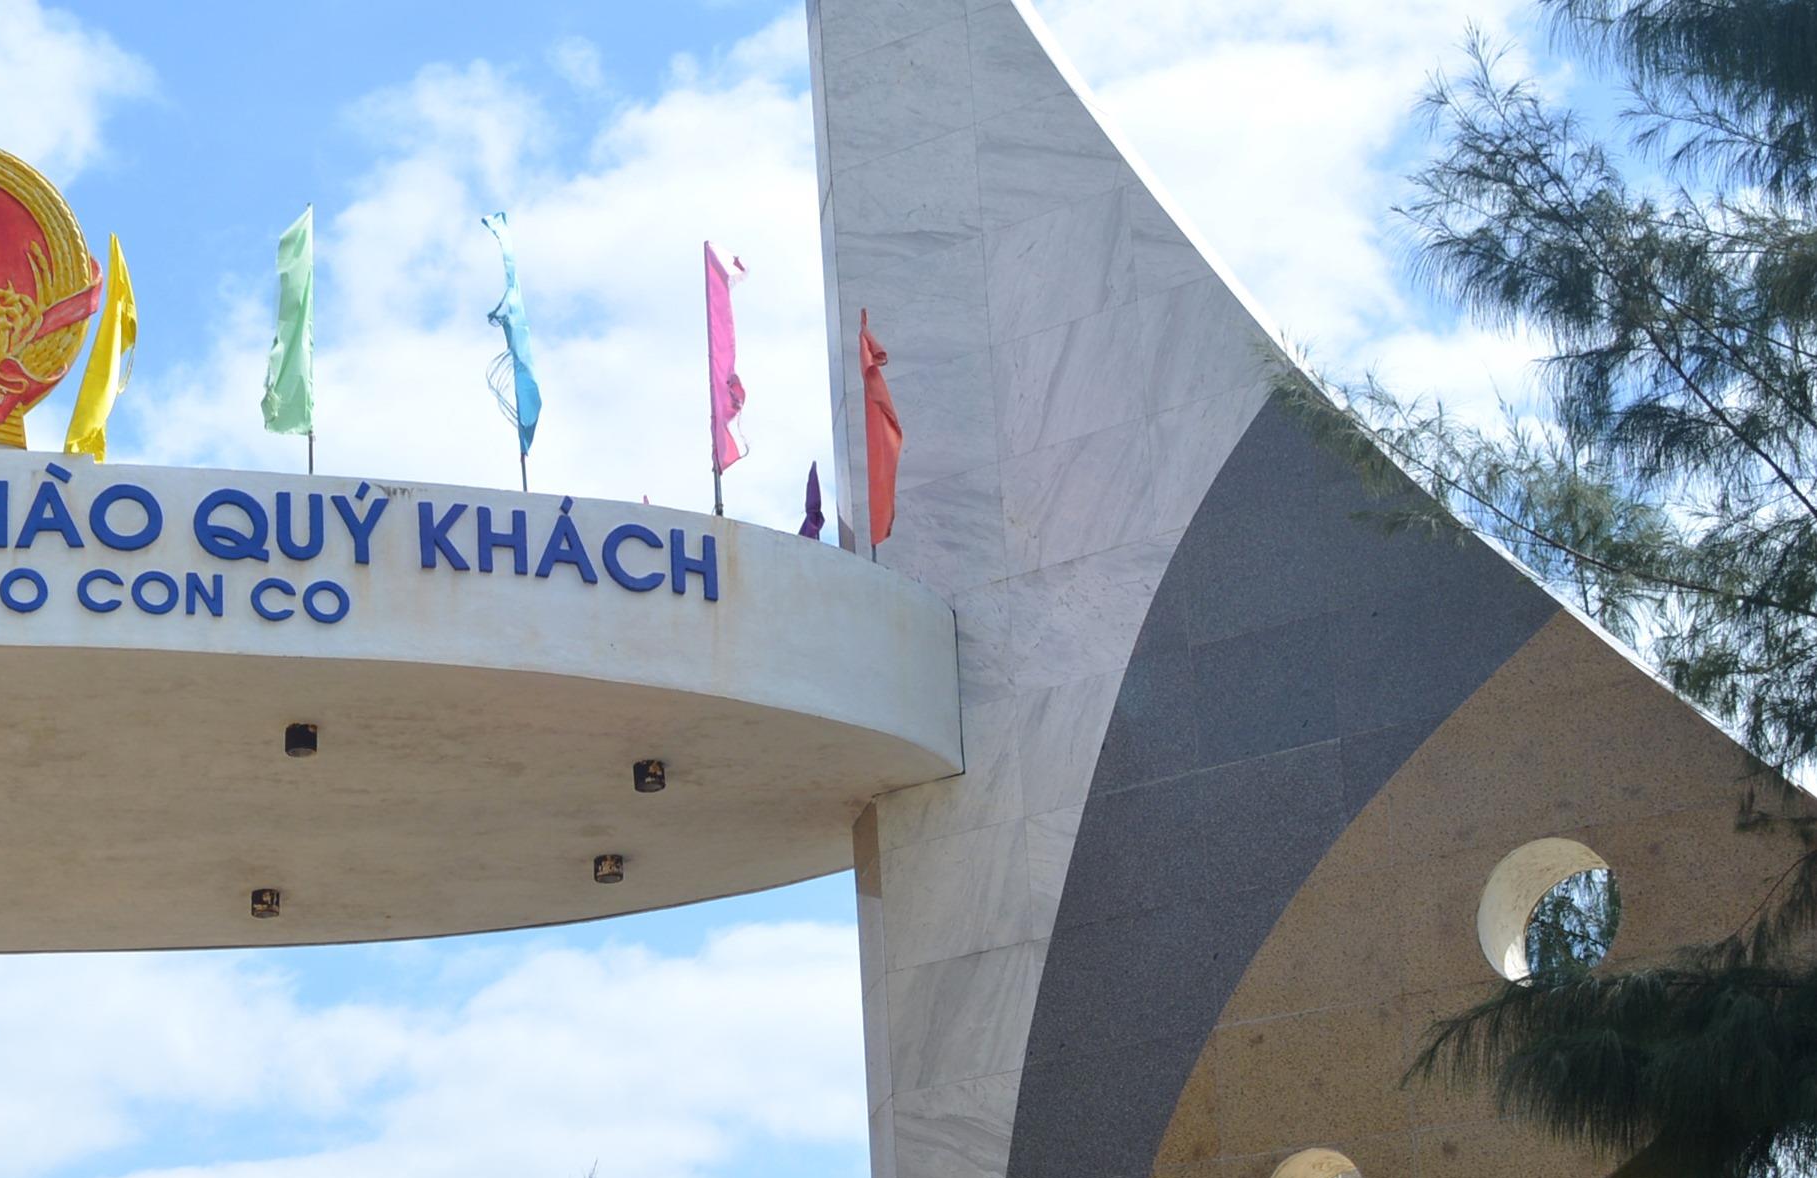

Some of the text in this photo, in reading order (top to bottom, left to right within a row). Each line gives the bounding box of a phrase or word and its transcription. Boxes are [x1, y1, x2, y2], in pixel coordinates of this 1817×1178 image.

[193, 481, 389, 565] QUÝ
[418, 496, 719, 601] KHÁCH
[77, 569, 224, 617] CON
[250, 578, 350, 624] CO
